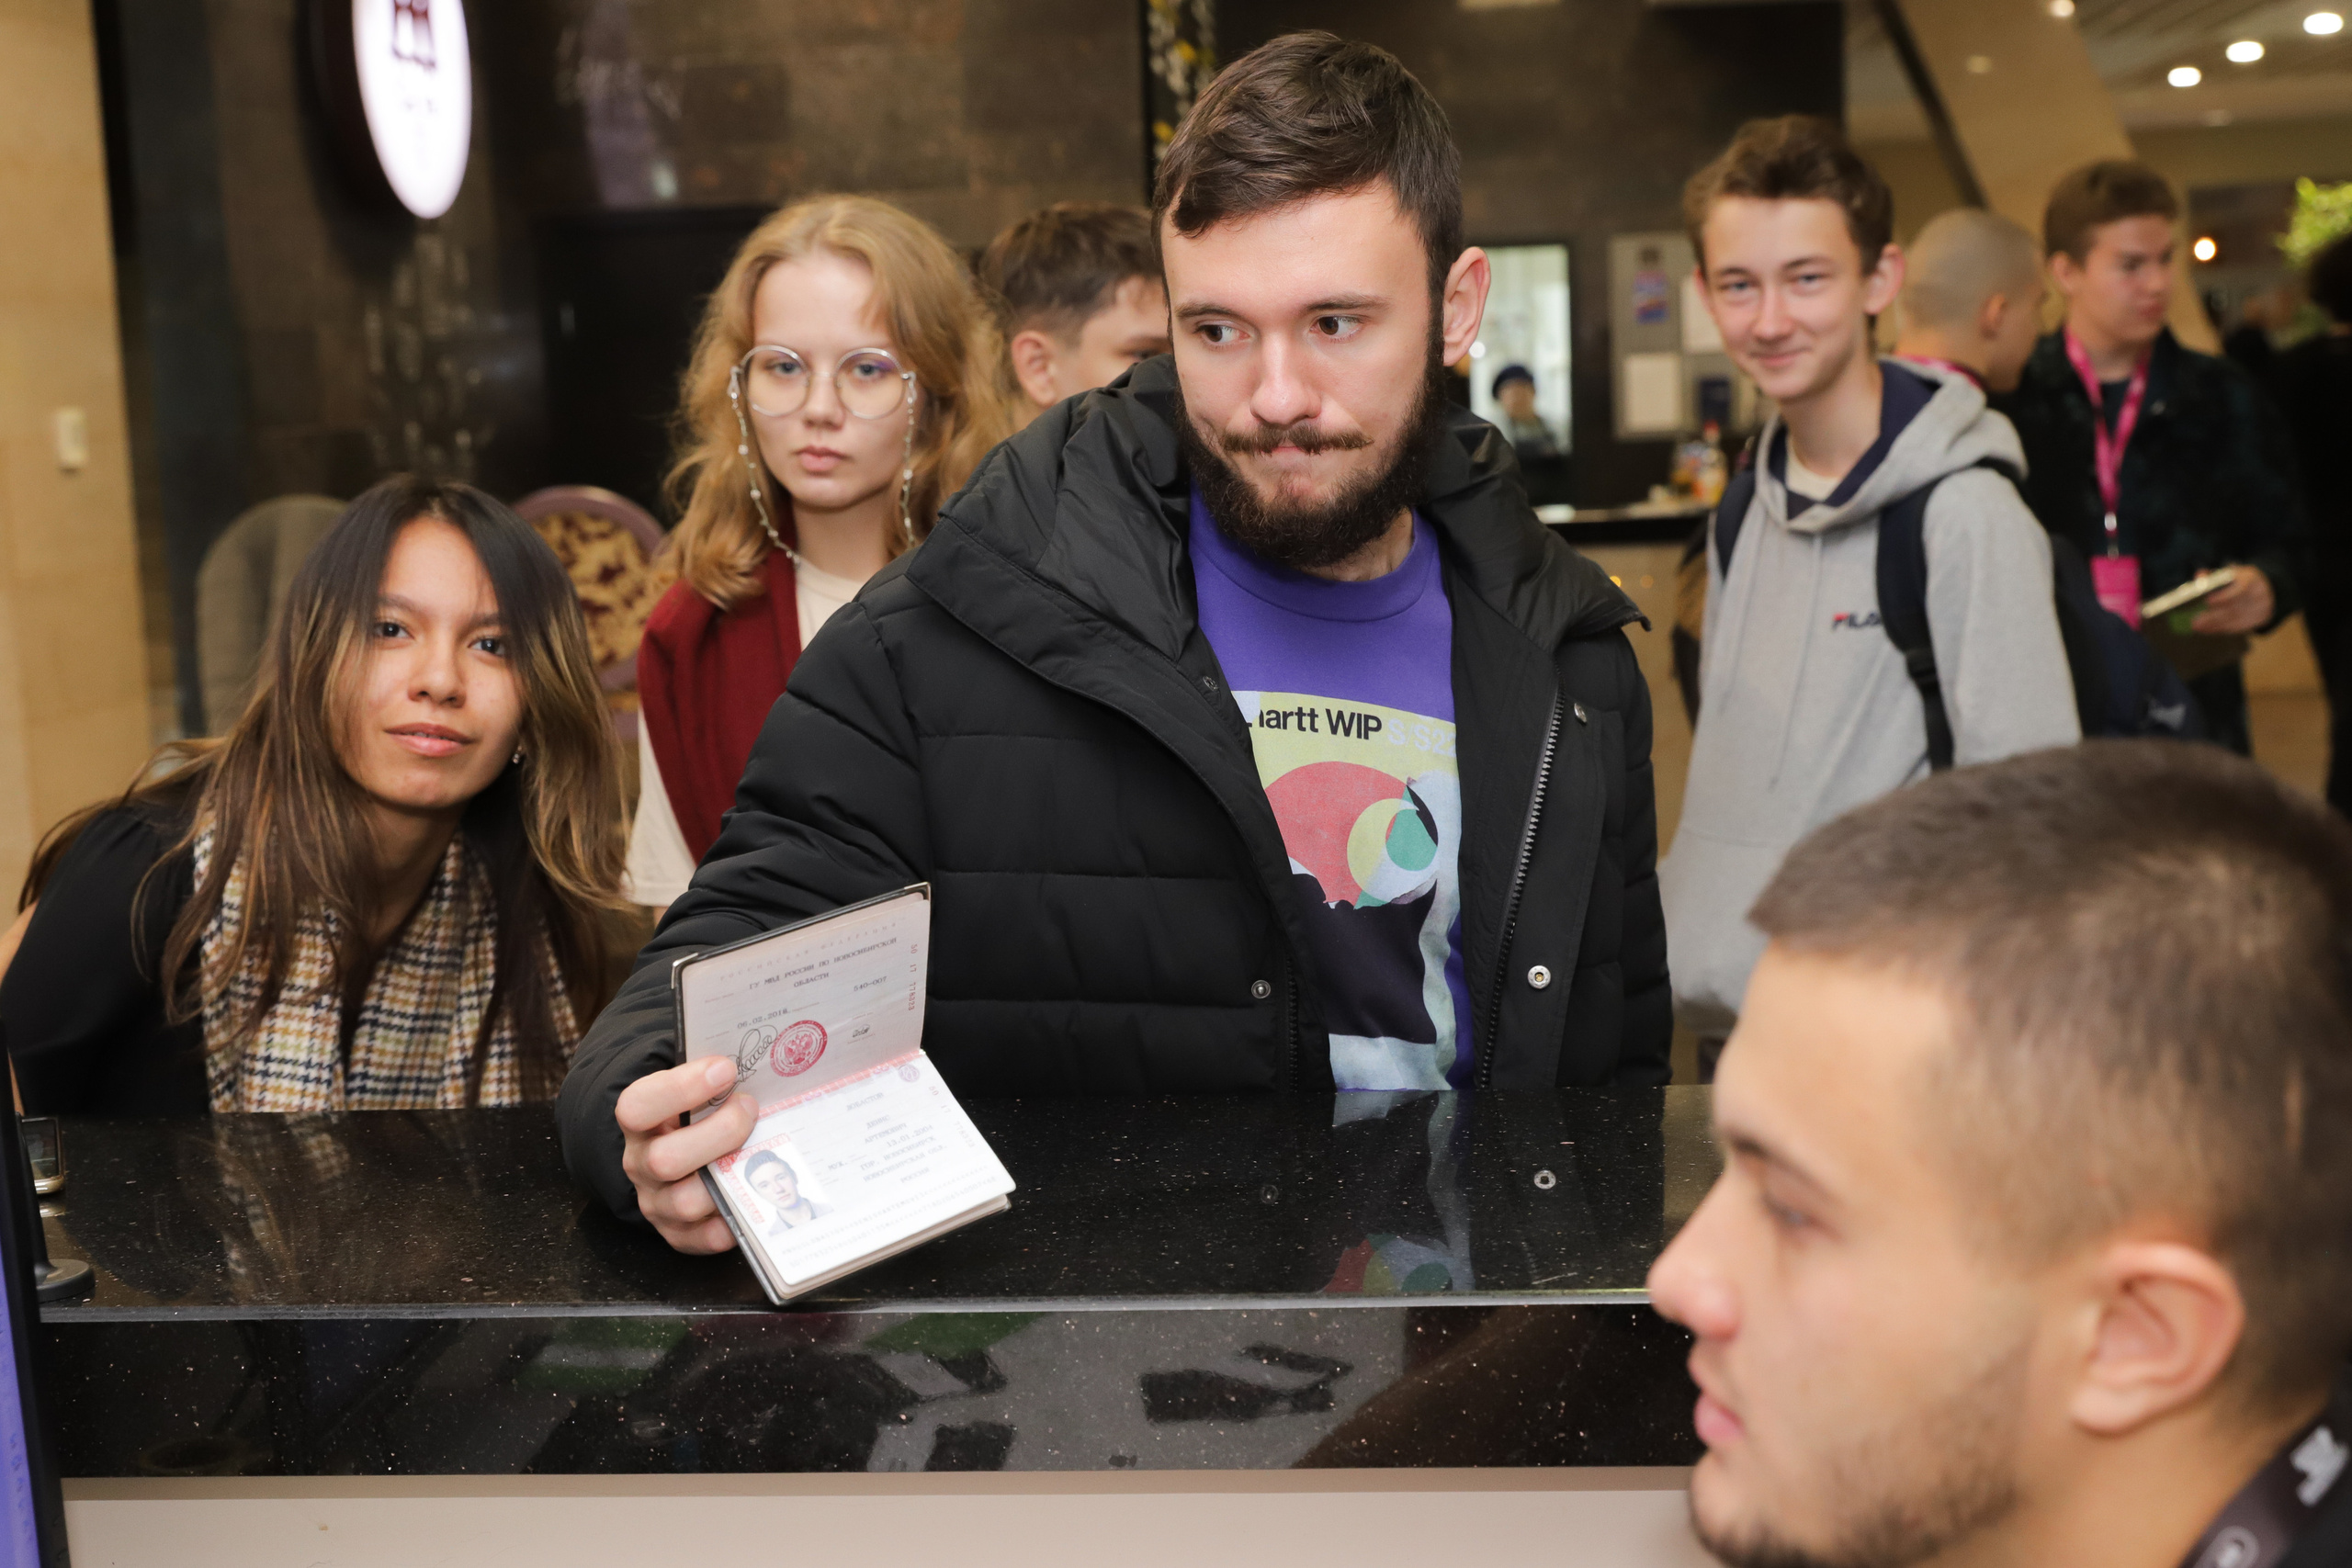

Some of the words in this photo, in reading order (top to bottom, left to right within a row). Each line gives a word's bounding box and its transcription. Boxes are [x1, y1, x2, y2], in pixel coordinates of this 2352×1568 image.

[1326, 708, 1382, 740] WIP
[785, 964, 815, 979] РОССИИ
[819, 959, 830, 968] ПО
[833, 937, 898, 964] НОВОСИБИРСКОЙ
[793, 972, 830, 988] ОБЛАСТИ
[854, 976, 888, 992] 540-007
